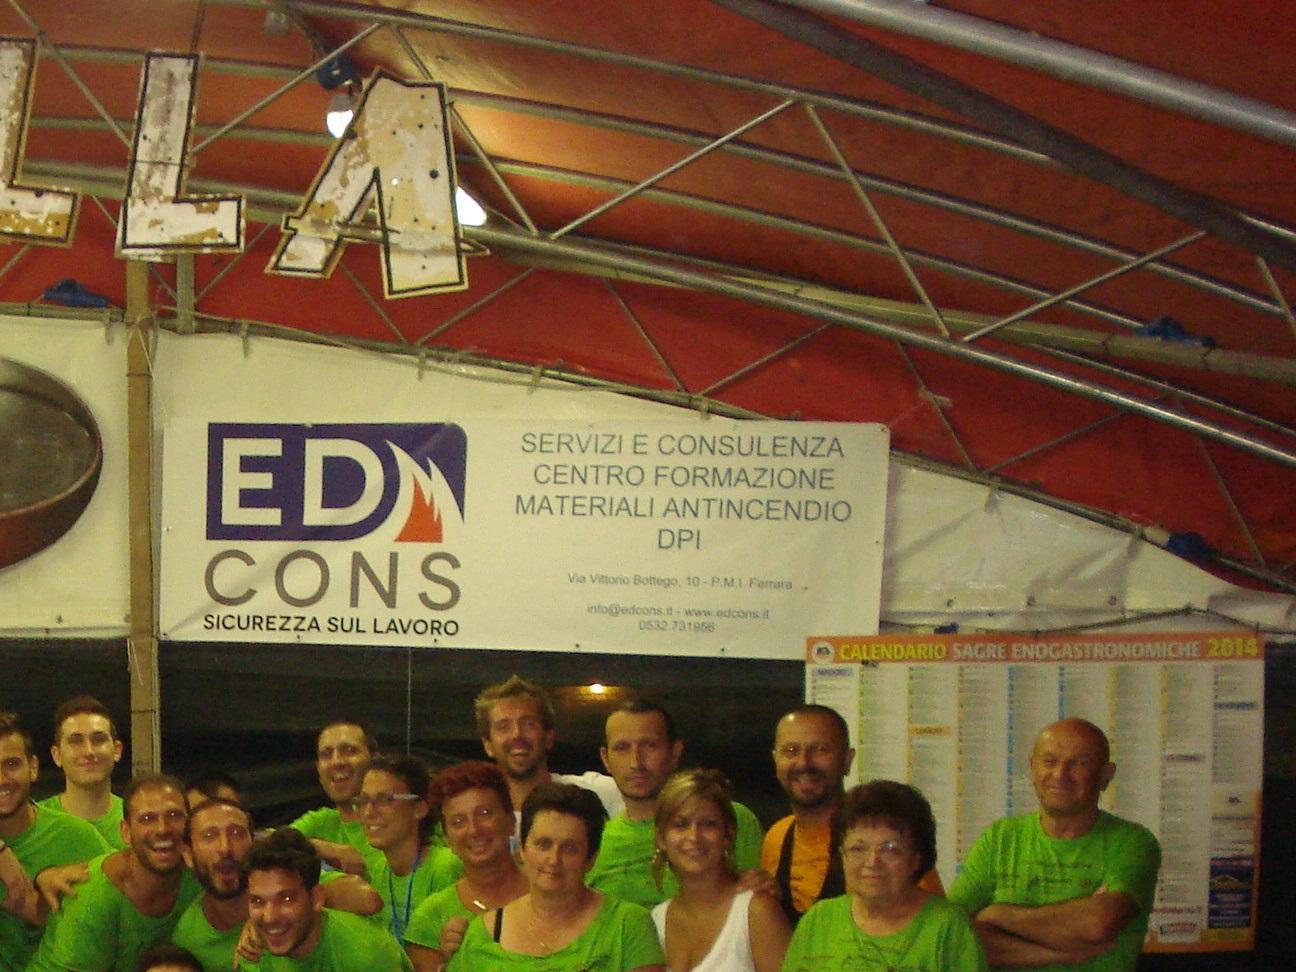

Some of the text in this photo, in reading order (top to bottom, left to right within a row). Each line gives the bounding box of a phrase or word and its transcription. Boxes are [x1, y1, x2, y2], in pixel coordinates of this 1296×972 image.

[521, 432, 845, 459] SERVIZI E CONSULENZA
[533, 464, 835, 490] CENTRO FORMAZIONE
[515, 495, 852, 522] MATERIALI ANTINCENDIO
[658, 529, 701, 550] DPI
[204, 549, 462, 611] CONS
[567, 573, 586, 584] Via
[203, 613, 459, 636] SICUREZZA SUL LAVORO
[840, 643, 946, 661] CALENDARIO
[954, 643, 1006, 660] SAGRE
[1012, 640, 1201, 659] ENOGASTRONOMICHE
